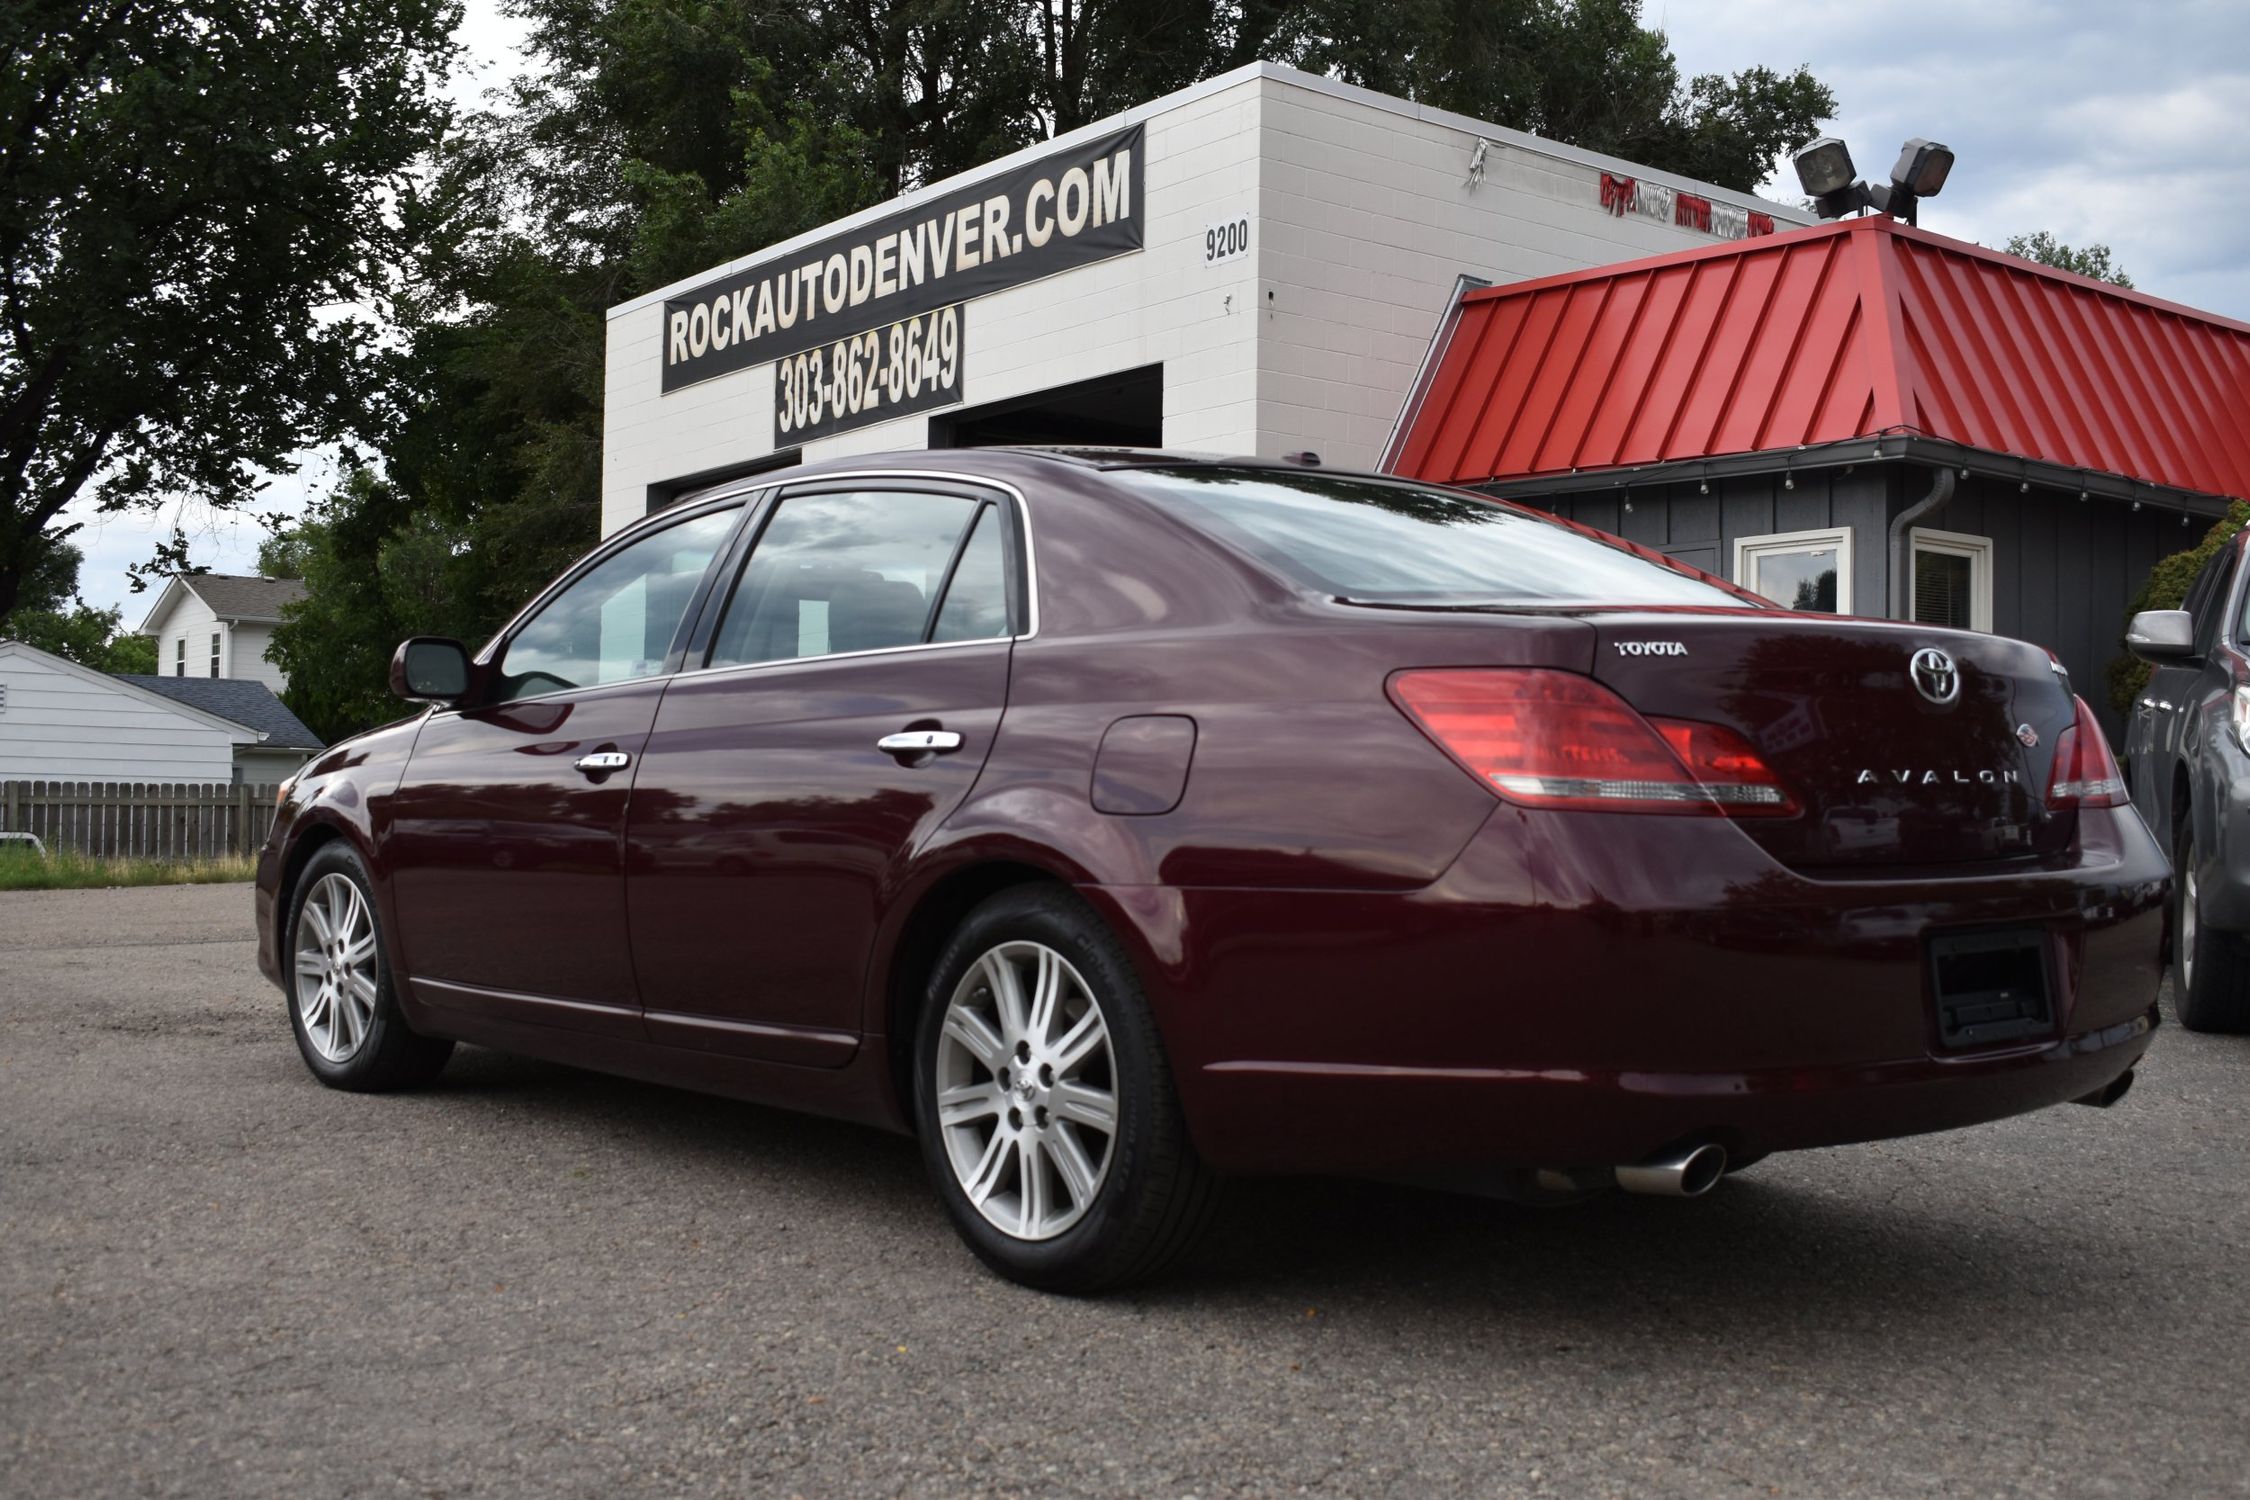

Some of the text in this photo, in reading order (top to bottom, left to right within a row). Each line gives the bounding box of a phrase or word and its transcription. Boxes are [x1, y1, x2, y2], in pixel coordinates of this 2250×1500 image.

[669, 149, 1132, 367] ROCKAUTODENVER.COM
[1205, 219, 1249, 263] 9200
[778, 306, 959, 434] 303-862-8649
[1613, 641, 1689, 656] TOYOTA
[1856, 768, 2019, 785] AVALON
